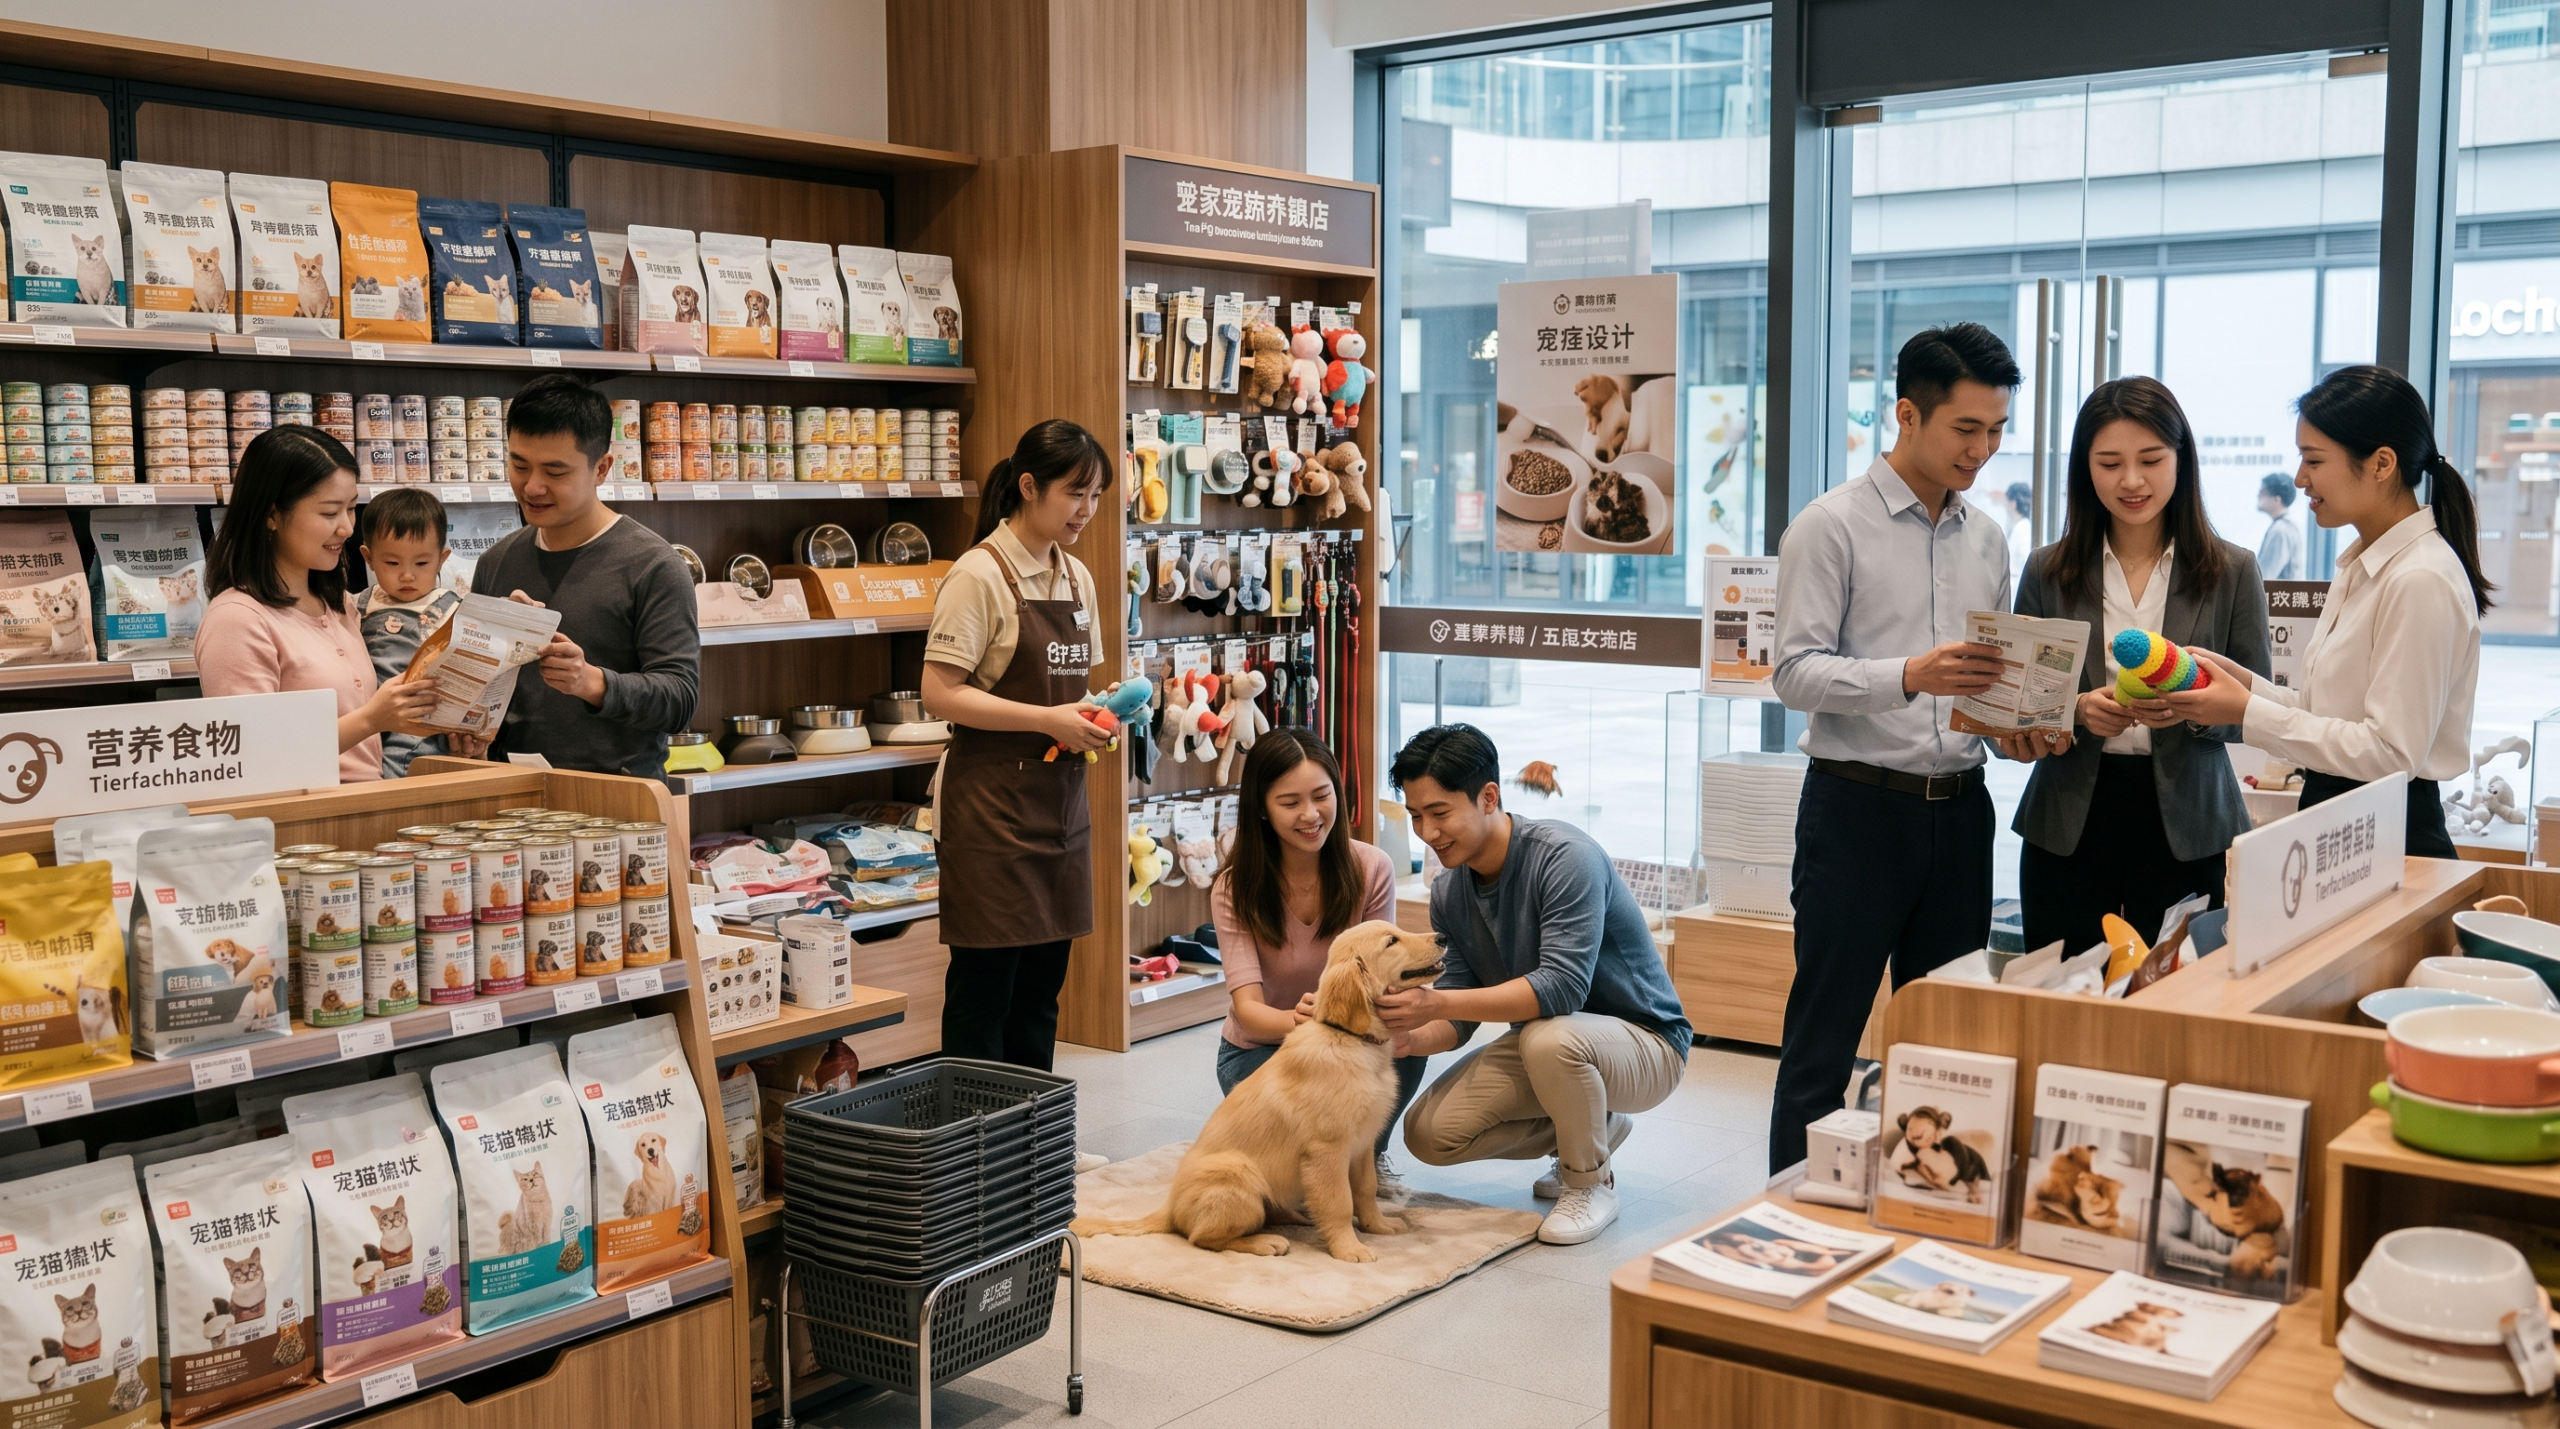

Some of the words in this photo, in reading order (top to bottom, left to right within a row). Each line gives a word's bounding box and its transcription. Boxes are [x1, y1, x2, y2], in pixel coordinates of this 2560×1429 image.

[2450, 285, 2560, 338] och
[86, 719, 242, 770] 营养食物
[88, 761, 244, 794] Tierfachhandel
